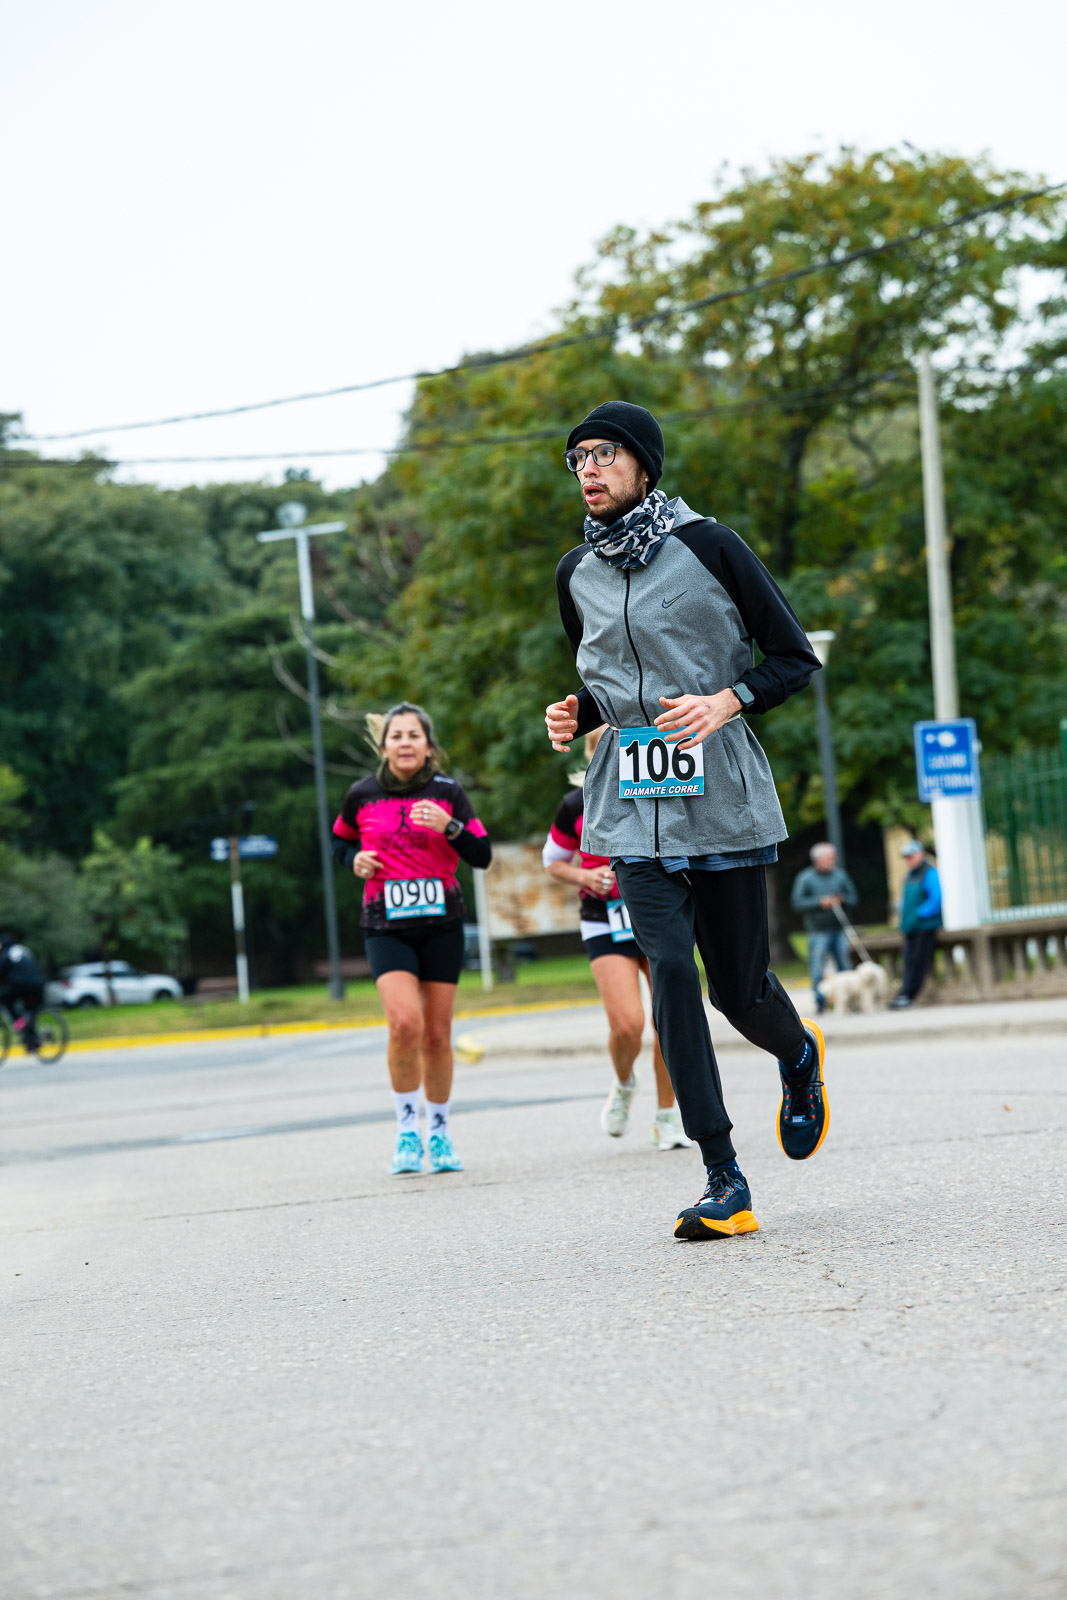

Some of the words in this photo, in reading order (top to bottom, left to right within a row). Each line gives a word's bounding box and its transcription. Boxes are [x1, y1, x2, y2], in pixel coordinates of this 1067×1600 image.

[625, 737, 696, 784] 106
[623, 786, 667, 796] DIAMANTE
[668, 784, 700, 794] CORRE
[390, 879, 437, 908] 090
